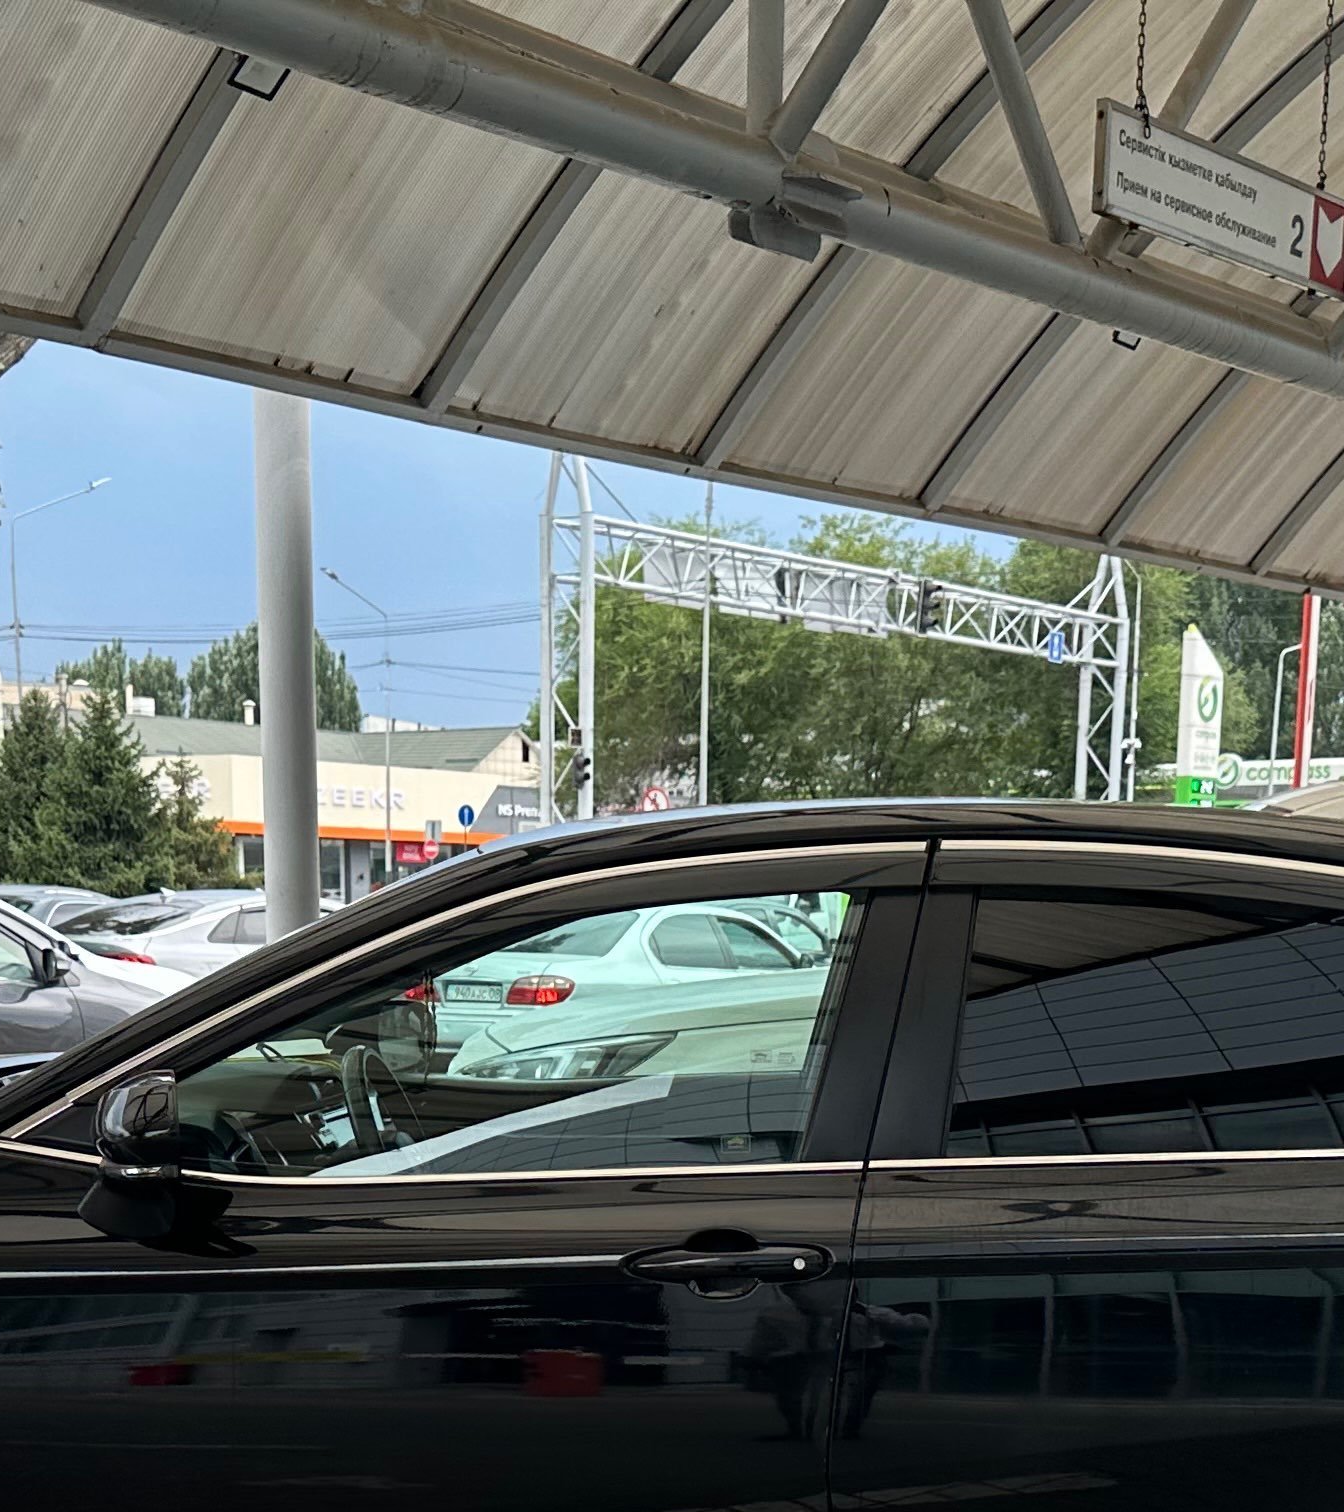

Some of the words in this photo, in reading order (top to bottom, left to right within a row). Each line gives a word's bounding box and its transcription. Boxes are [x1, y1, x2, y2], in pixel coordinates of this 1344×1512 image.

[1119, 128, 1167, 164] Сервистік
[1117, 171, 1148, 199] Прием
[1150, 188, 1162, 204] на
[1164, 193, 1213, 224] сервисное
[1290, 214, 1304, 258] 2
